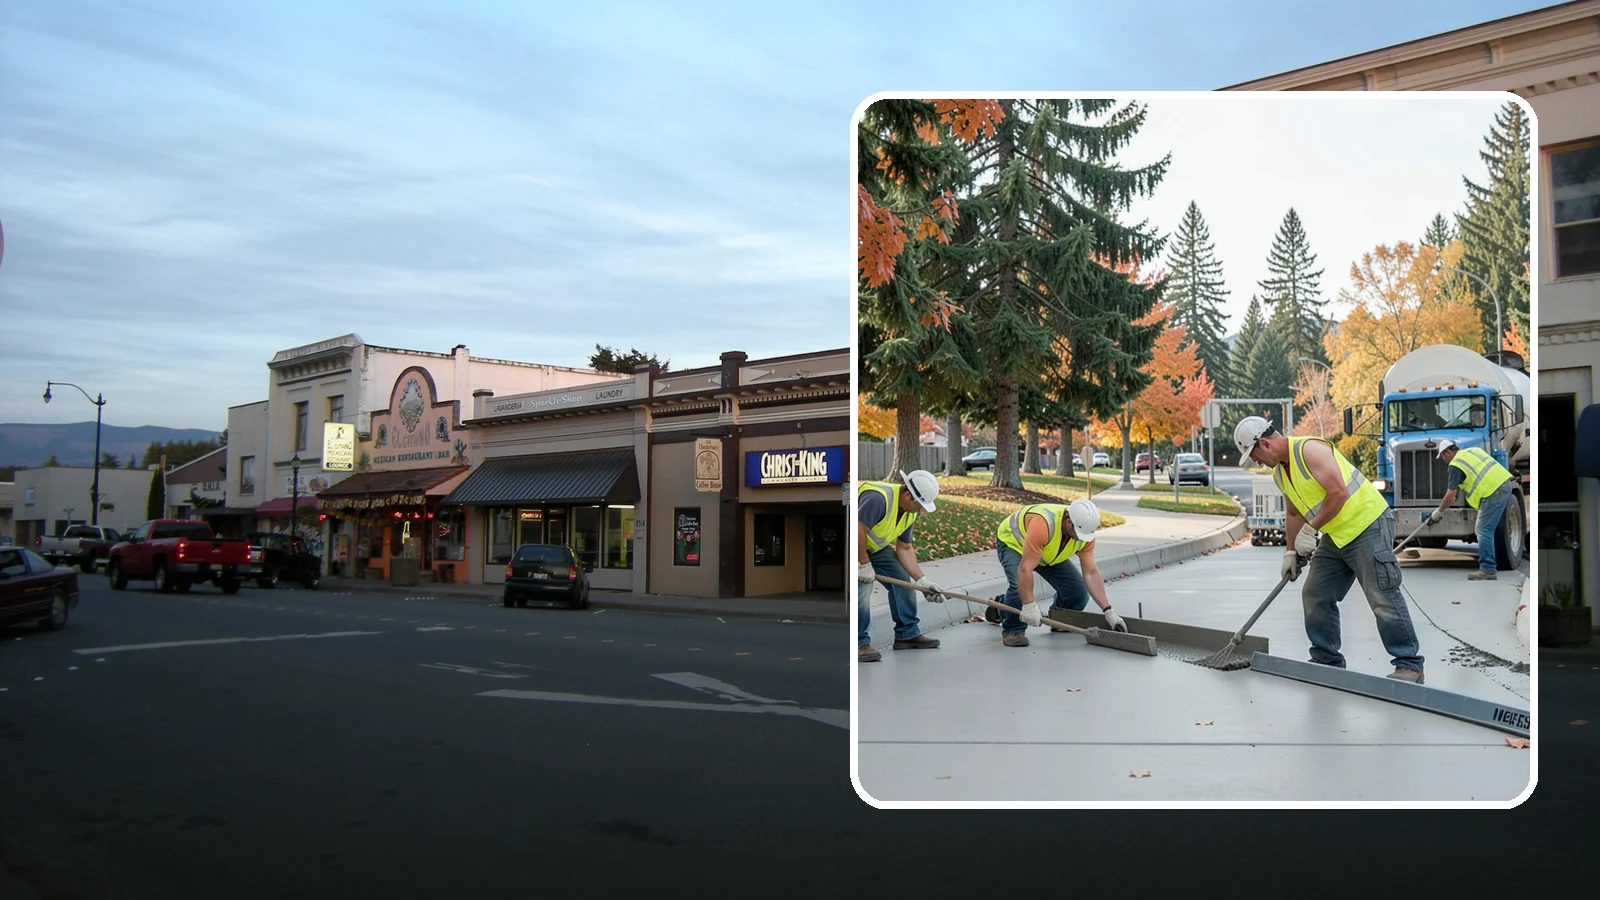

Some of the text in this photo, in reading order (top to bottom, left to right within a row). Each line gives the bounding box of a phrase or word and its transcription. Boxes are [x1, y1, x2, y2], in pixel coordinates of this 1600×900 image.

[493, 389, 623, 412] LAVANDERIA Sparkle Shop LAUNDRY
[374, 455, 396, 464] MEXICAN
[398, 451, 433, 462] RESTAURANT
[438, 450, 450, 459] BAR
[761, 450, 827, 478] CHRIST KING
